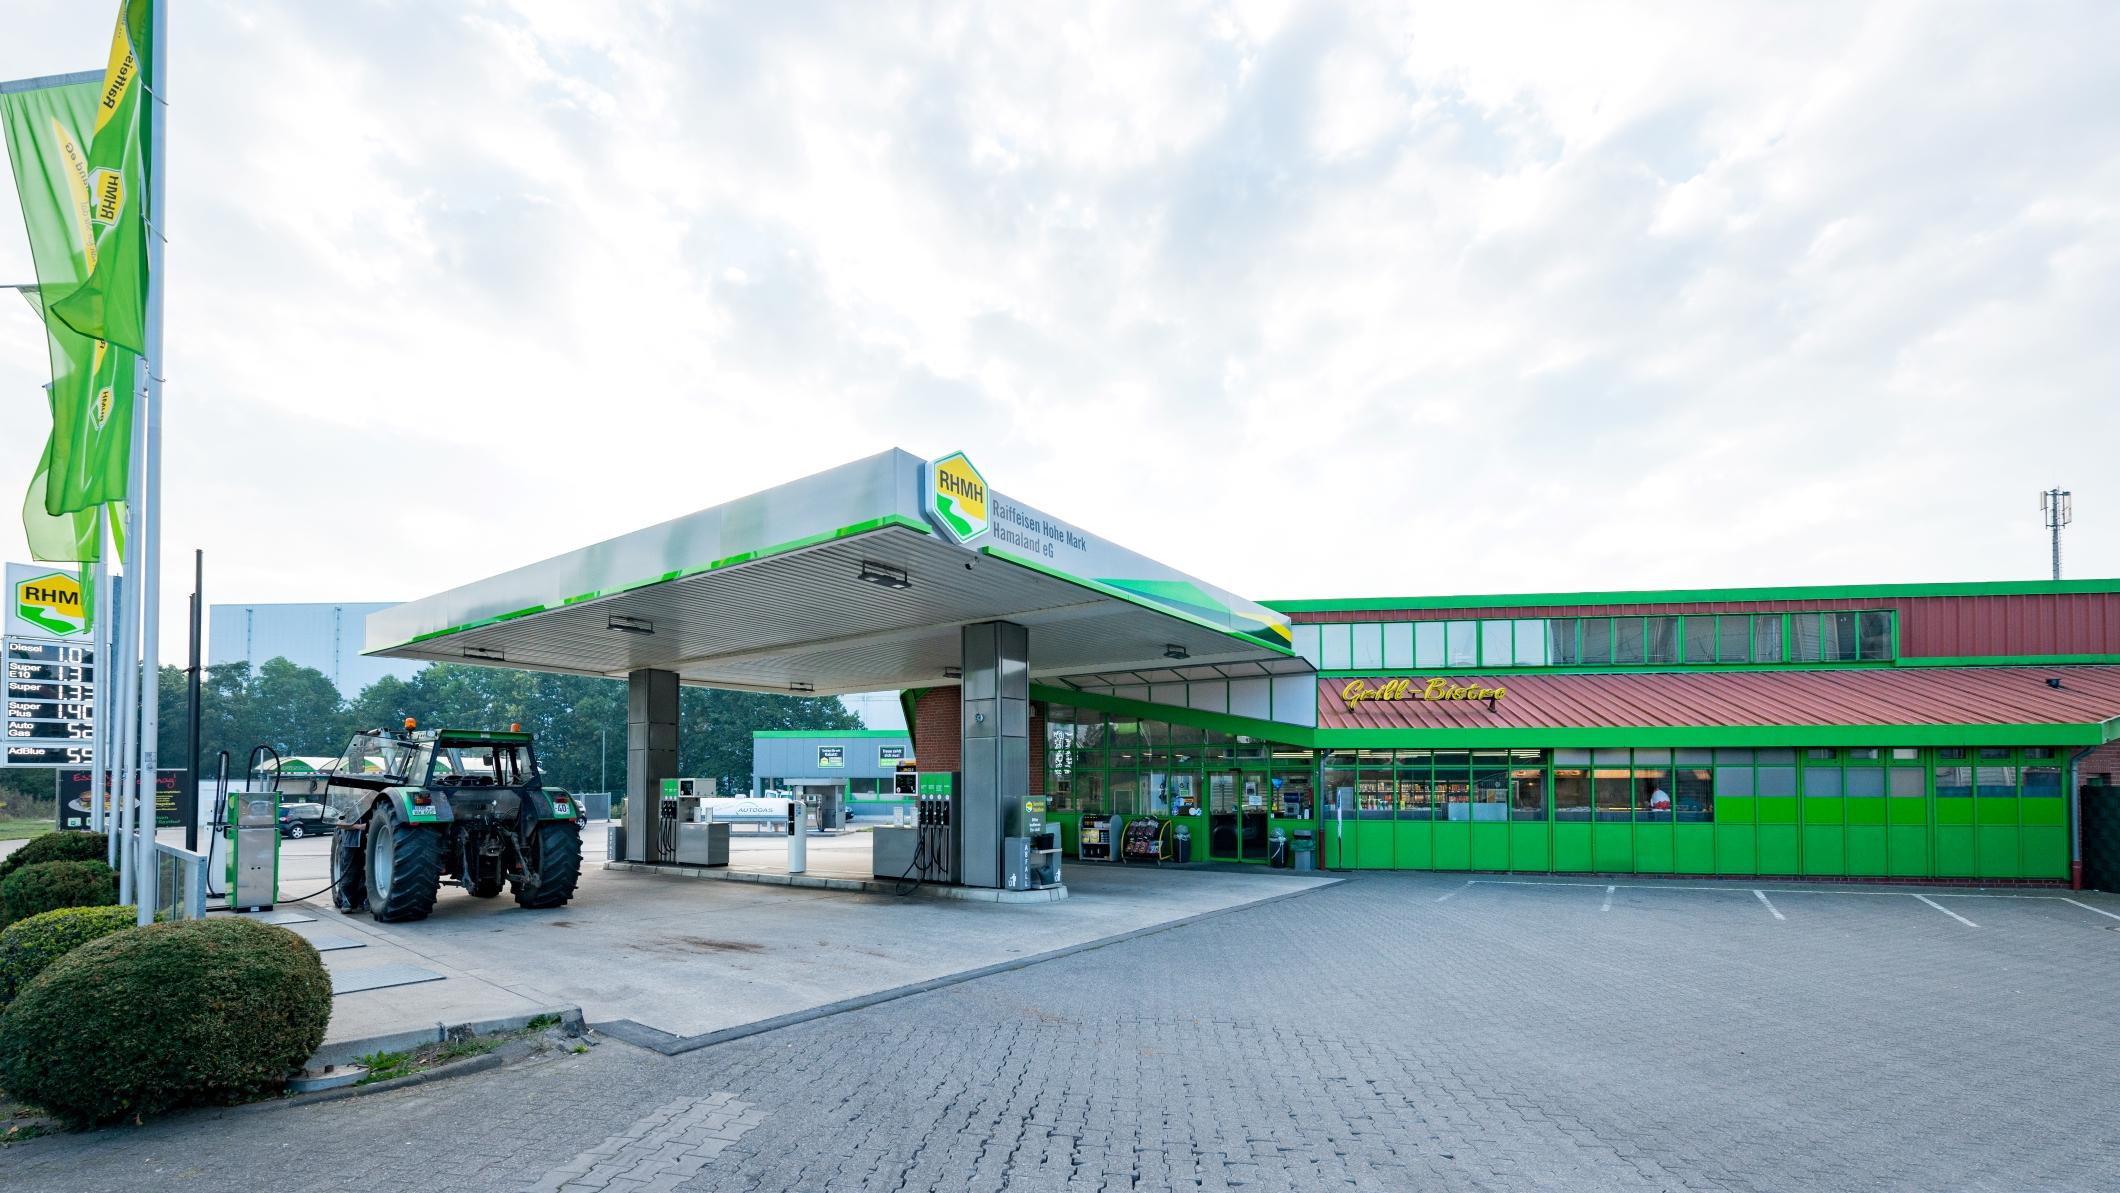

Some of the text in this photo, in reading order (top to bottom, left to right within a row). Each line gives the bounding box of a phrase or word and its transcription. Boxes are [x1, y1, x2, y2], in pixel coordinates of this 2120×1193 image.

[939, 470, 983, 503] RHMH
[992, 500, 1087, 552] Raiffeisen Hohe Mark
[993, 521, 1054, 559] Hamaland eG
[25, 586, 79, 605] RHM
[9, 643, 42, 652] Diesel
[9, 663, 41, 672] Super
[9, 683, 41, 691] Super
[1342, 677, 1507, 710] Grill-Bistro
[9, 702, 41, 710] Super
[8, 710, 32, 718] Plus
[8, 747, 46, 755] AdBlue
